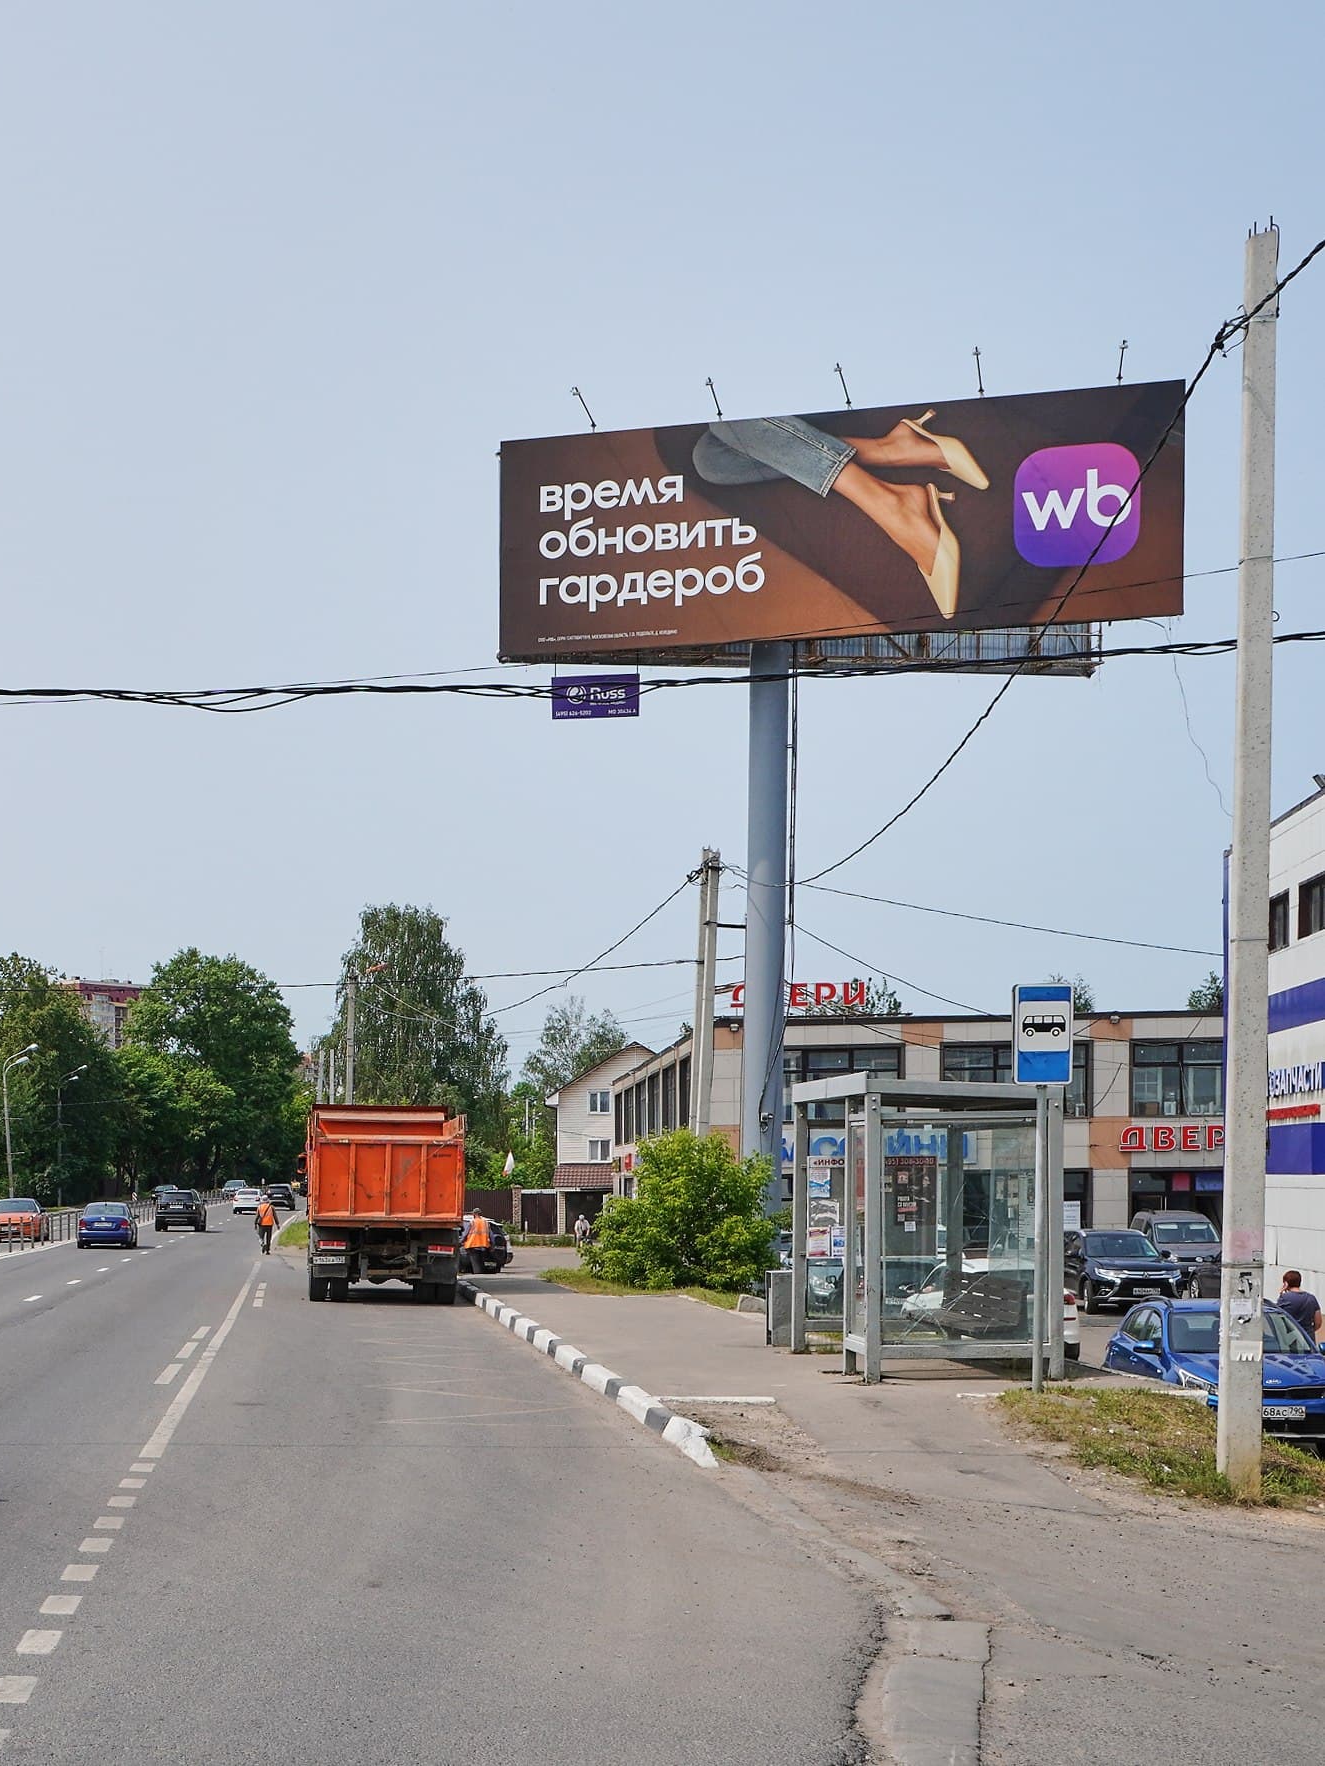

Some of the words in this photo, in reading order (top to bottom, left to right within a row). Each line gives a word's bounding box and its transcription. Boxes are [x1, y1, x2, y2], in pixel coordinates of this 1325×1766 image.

[539, 475, 684, 521] время
[1022, 468, 1132, 531] wb
[539, 516, 757, 560] обновить
[539, 552, 765, 612] гардероб
[590, 687, 626, 700] Russ
[730, 981, 866, 1008] ДЕРИ
[1119, 1125, 1225, 1152] ДВЕР
[813, 1158, 845, 1166] «ИНФО
